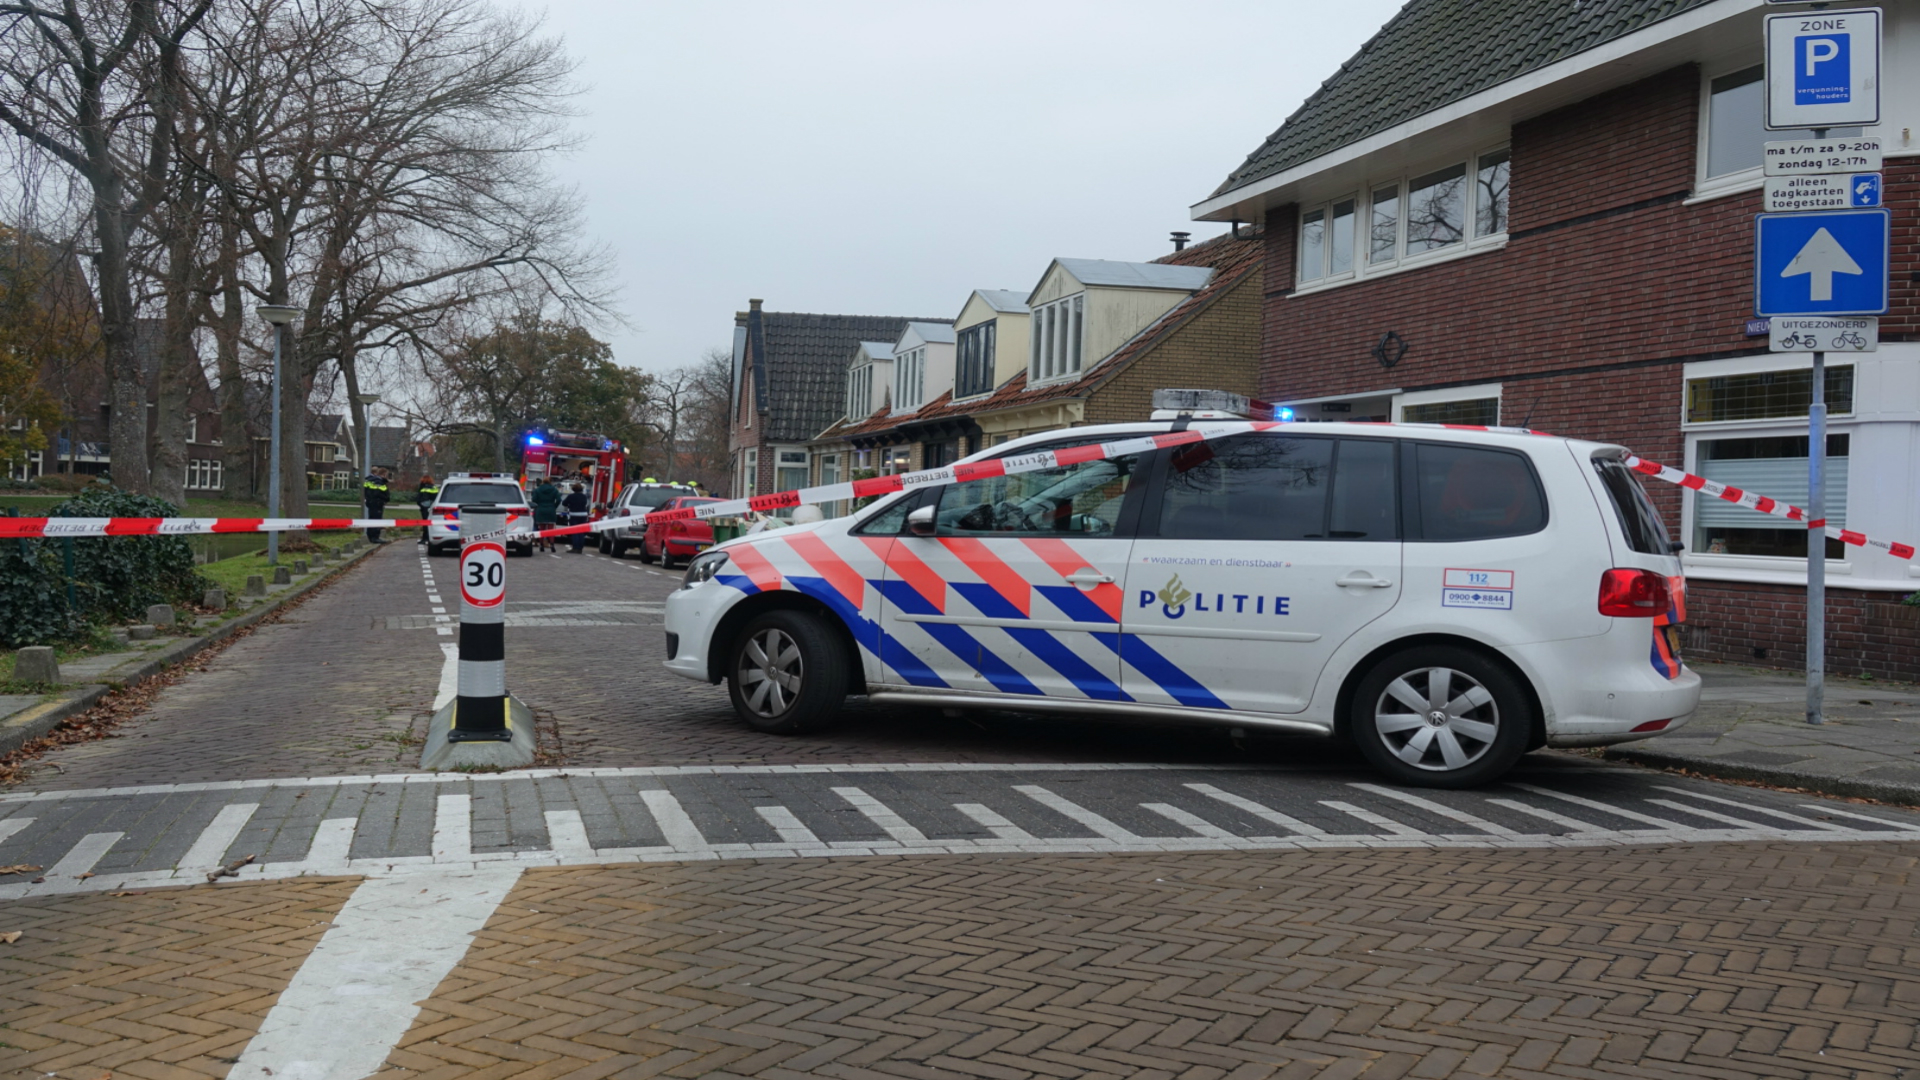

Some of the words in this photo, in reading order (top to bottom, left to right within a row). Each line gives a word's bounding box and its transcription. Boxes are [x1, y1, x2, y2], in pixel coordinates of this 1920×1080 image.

[1800, 19, 1846, 31] ZONE
[1806, 38, 1839, 76] P
[1797, 86, 1849, 94] vergunning-
[1790, 145, 1814, 154] t/m
[1838, 142, 1879, 152] 9-20h
[1778, 160, 1822, 169] zondag
[1827, 157, 1867, 166] 12-17h
[1789, 178, 1827, 187] alleen
[1772, 188, 1844, 199] dagkaarten
[1772, 198, 1844, 209] toegestaan
[1747, 321, 1770, 333] NIEU
[1782, 321, 1867, 329] UITGEZONDERD
[951, 467, 975, 478] NIET
[892, 471, 949, 487] BETREDEN
[630, 511, 688, 526] BETREDEN
[691, 507, 715, 520] NIET
[1151, 557, 1206, 565] waakzaam
[1226, 558, 1283, 568] dienstbaar
[466, 562, 503, 587] 30
[1469, 573, 1488, 582] 112
[1449, 593, 1470, 601] 0900
[1139, 590, 1290, 619] POLITIE
